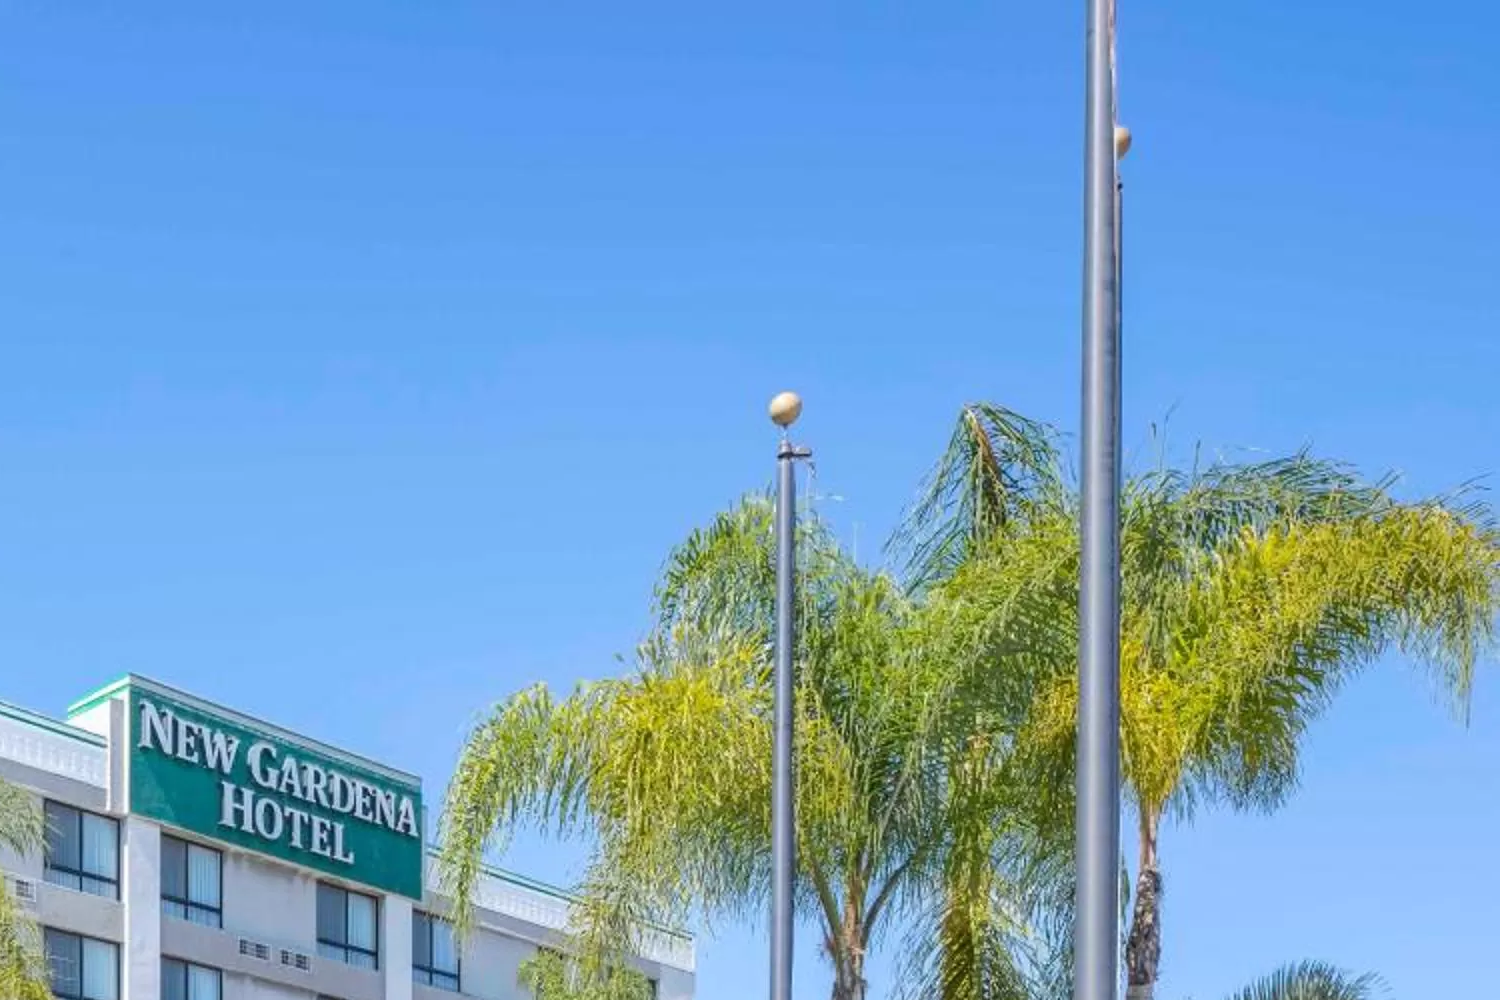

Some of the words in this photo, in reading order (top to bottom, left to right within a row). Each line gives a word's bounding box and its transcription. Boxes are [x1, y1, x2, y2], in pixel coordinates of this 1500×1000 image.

[137, 700, 240, 774] NEW
[247, 742, 419, 838] GARDENA
[217, 780, 355, 865] HOTEL
